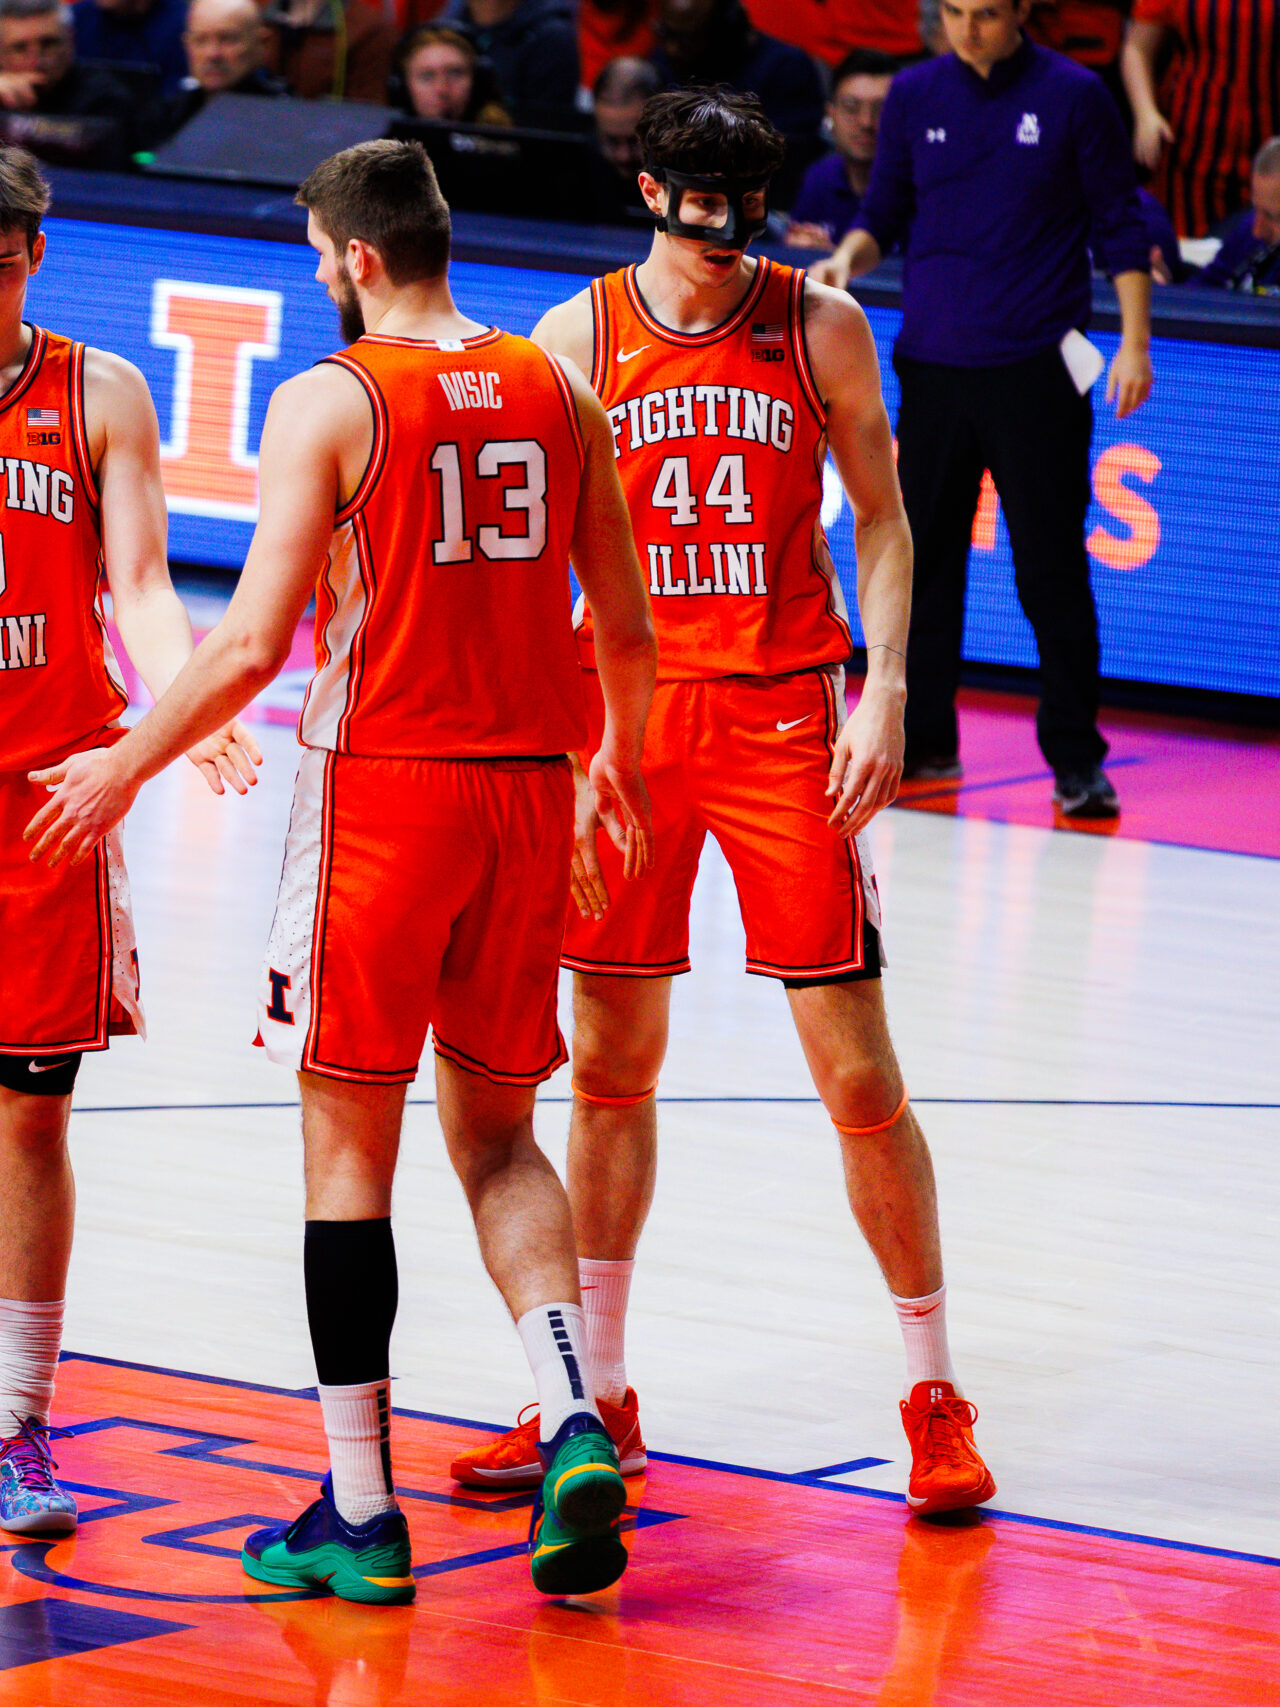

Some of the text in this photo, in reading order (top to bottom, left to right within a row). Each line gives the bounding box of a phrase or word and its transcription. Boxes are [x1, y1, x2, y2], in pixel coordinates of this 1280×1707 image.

[437, 370, 503, 411] IVISIC
[605, 384, 795, 460] FIGHTING
[429, 438, 548, 566] 13
[651, 454, 753, 526] 44
[647, 543, 768, 597] ILLINI
